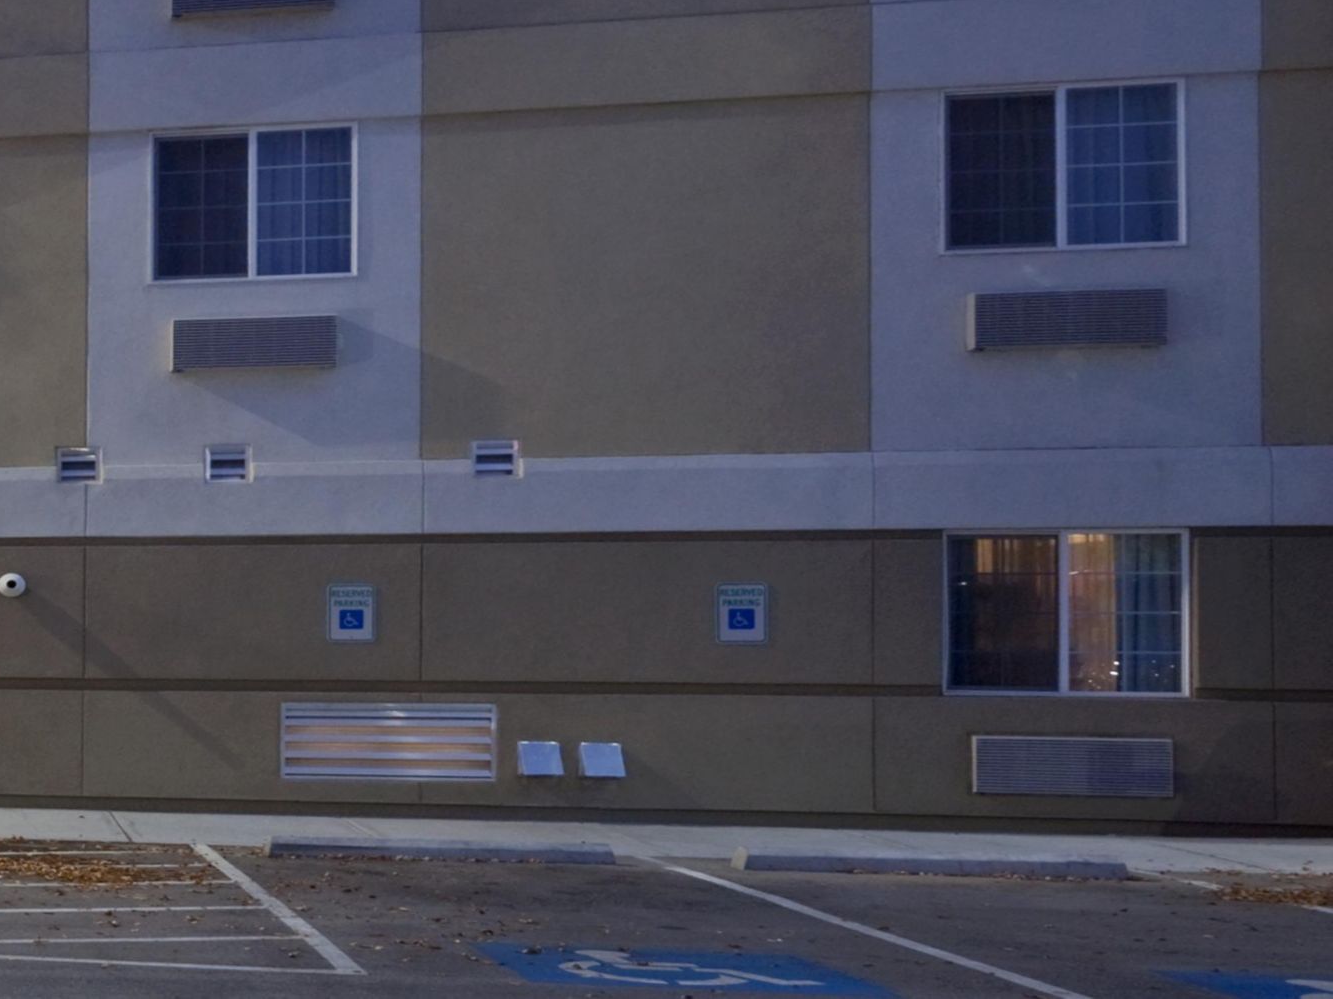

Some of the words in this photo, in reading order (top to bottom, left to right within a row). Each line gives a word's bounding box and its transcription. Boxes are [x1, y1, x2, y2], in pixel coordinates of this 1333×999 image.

[331, 590, 371, 598] RESERVED
[720, 588, 763, 597] RESERVED
[333, 599, 370, 607] PARKING
[722, 598, 761, 607] PARKING
